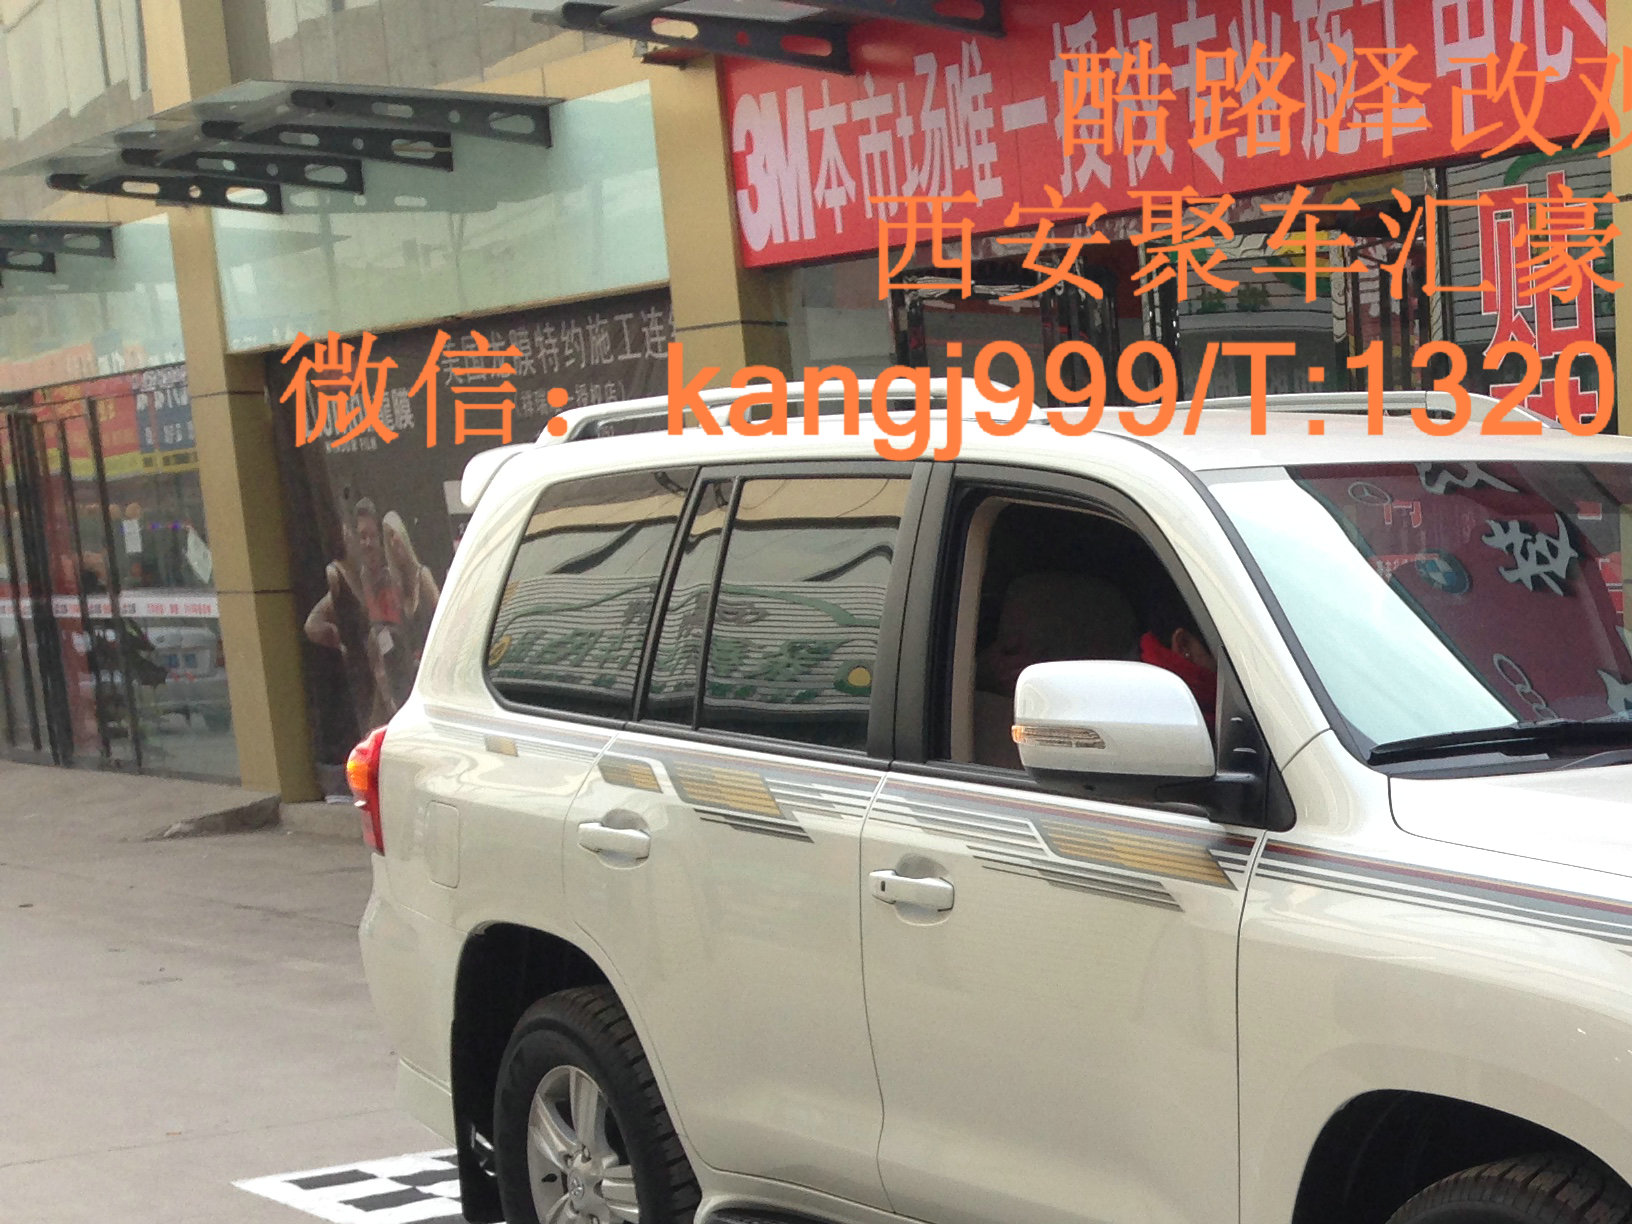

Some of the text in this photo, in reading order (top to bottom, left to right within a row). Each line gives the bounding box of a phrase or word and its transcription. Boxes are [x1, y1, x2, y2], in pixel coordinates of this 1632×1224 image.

[439, 307, 678, 386] 美国龙膜特约施工连
